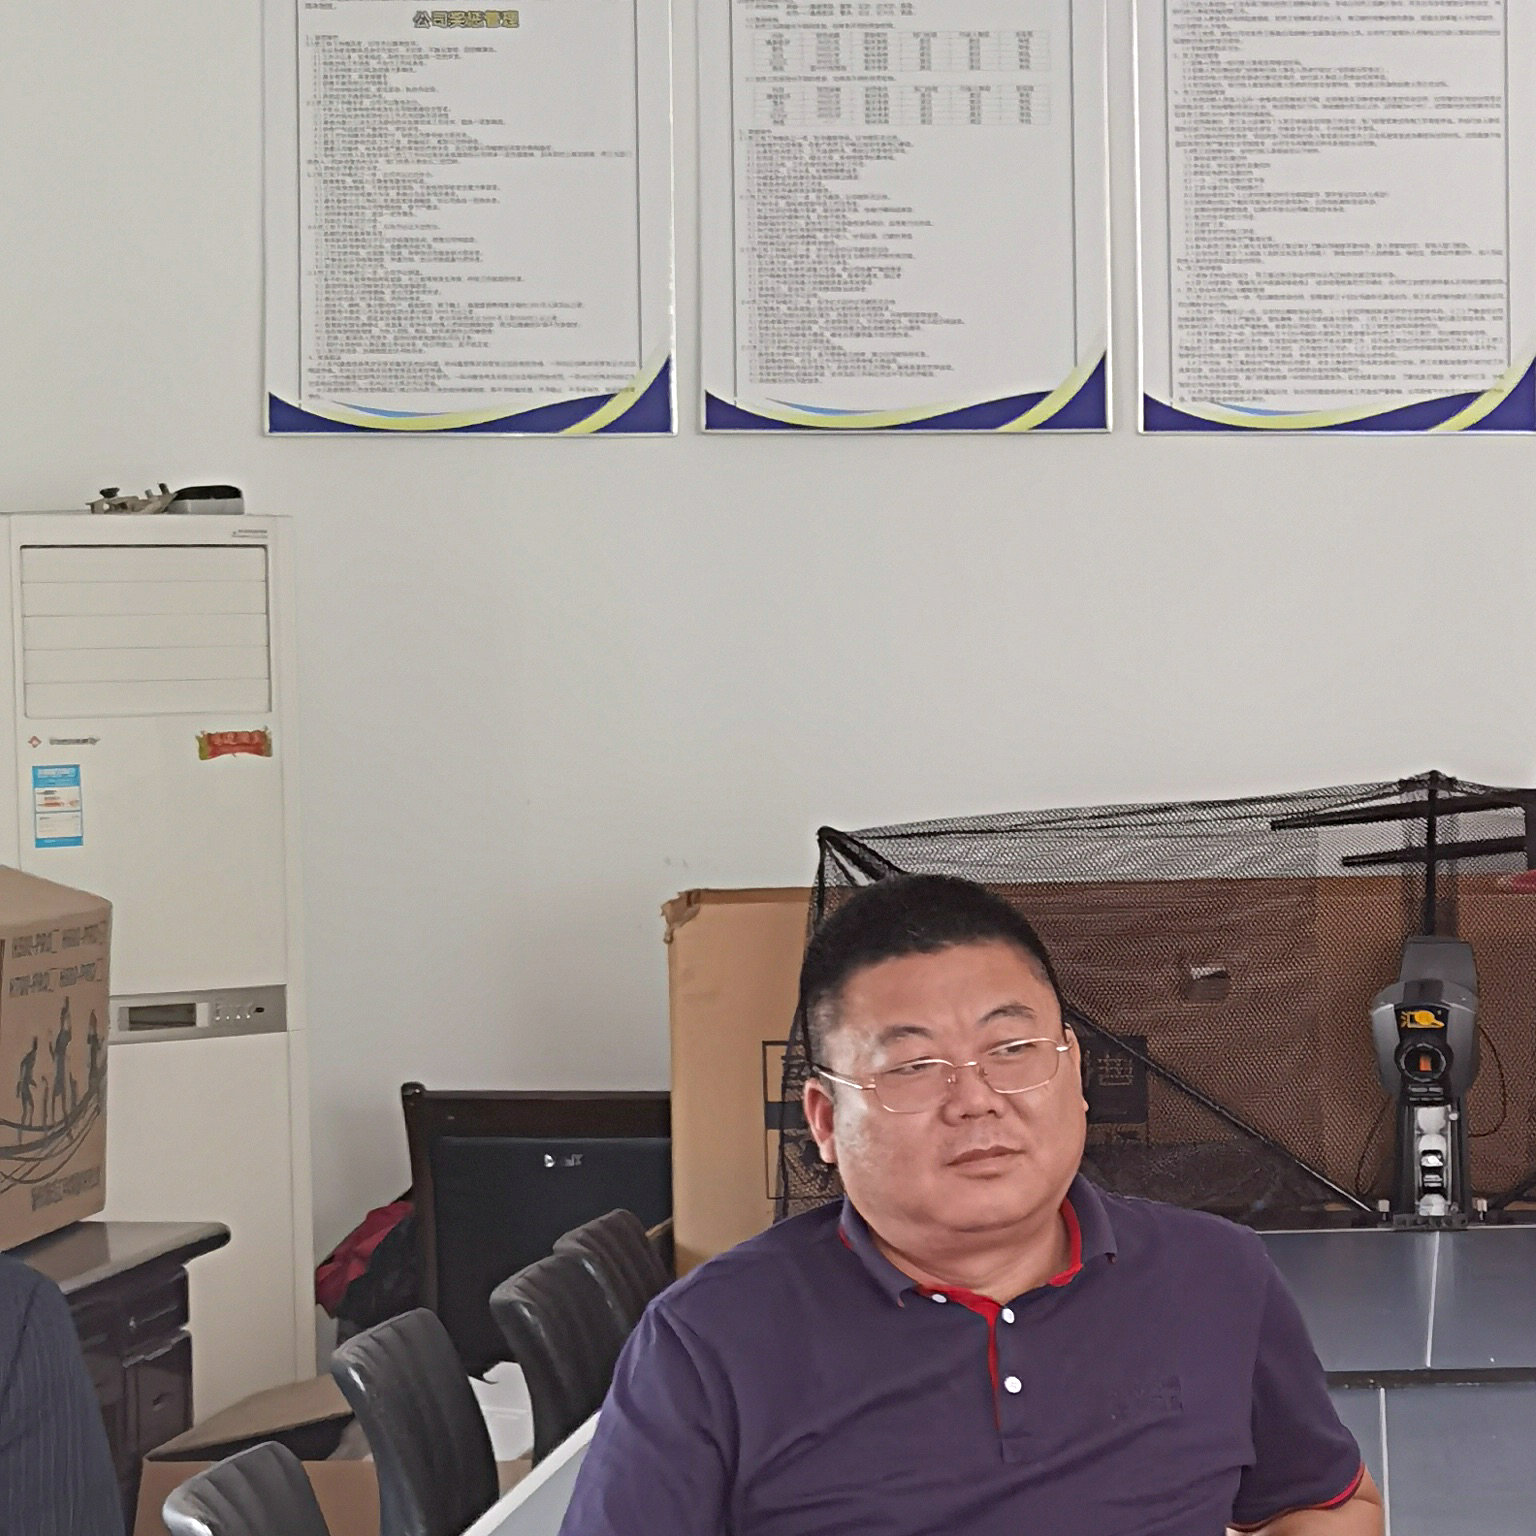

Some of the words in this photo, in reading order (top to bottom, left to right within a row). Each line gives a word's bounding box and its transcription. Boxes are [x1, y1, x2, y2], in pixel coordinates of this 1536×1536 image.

[412, 10, 520, 29] 公司奖惩理
